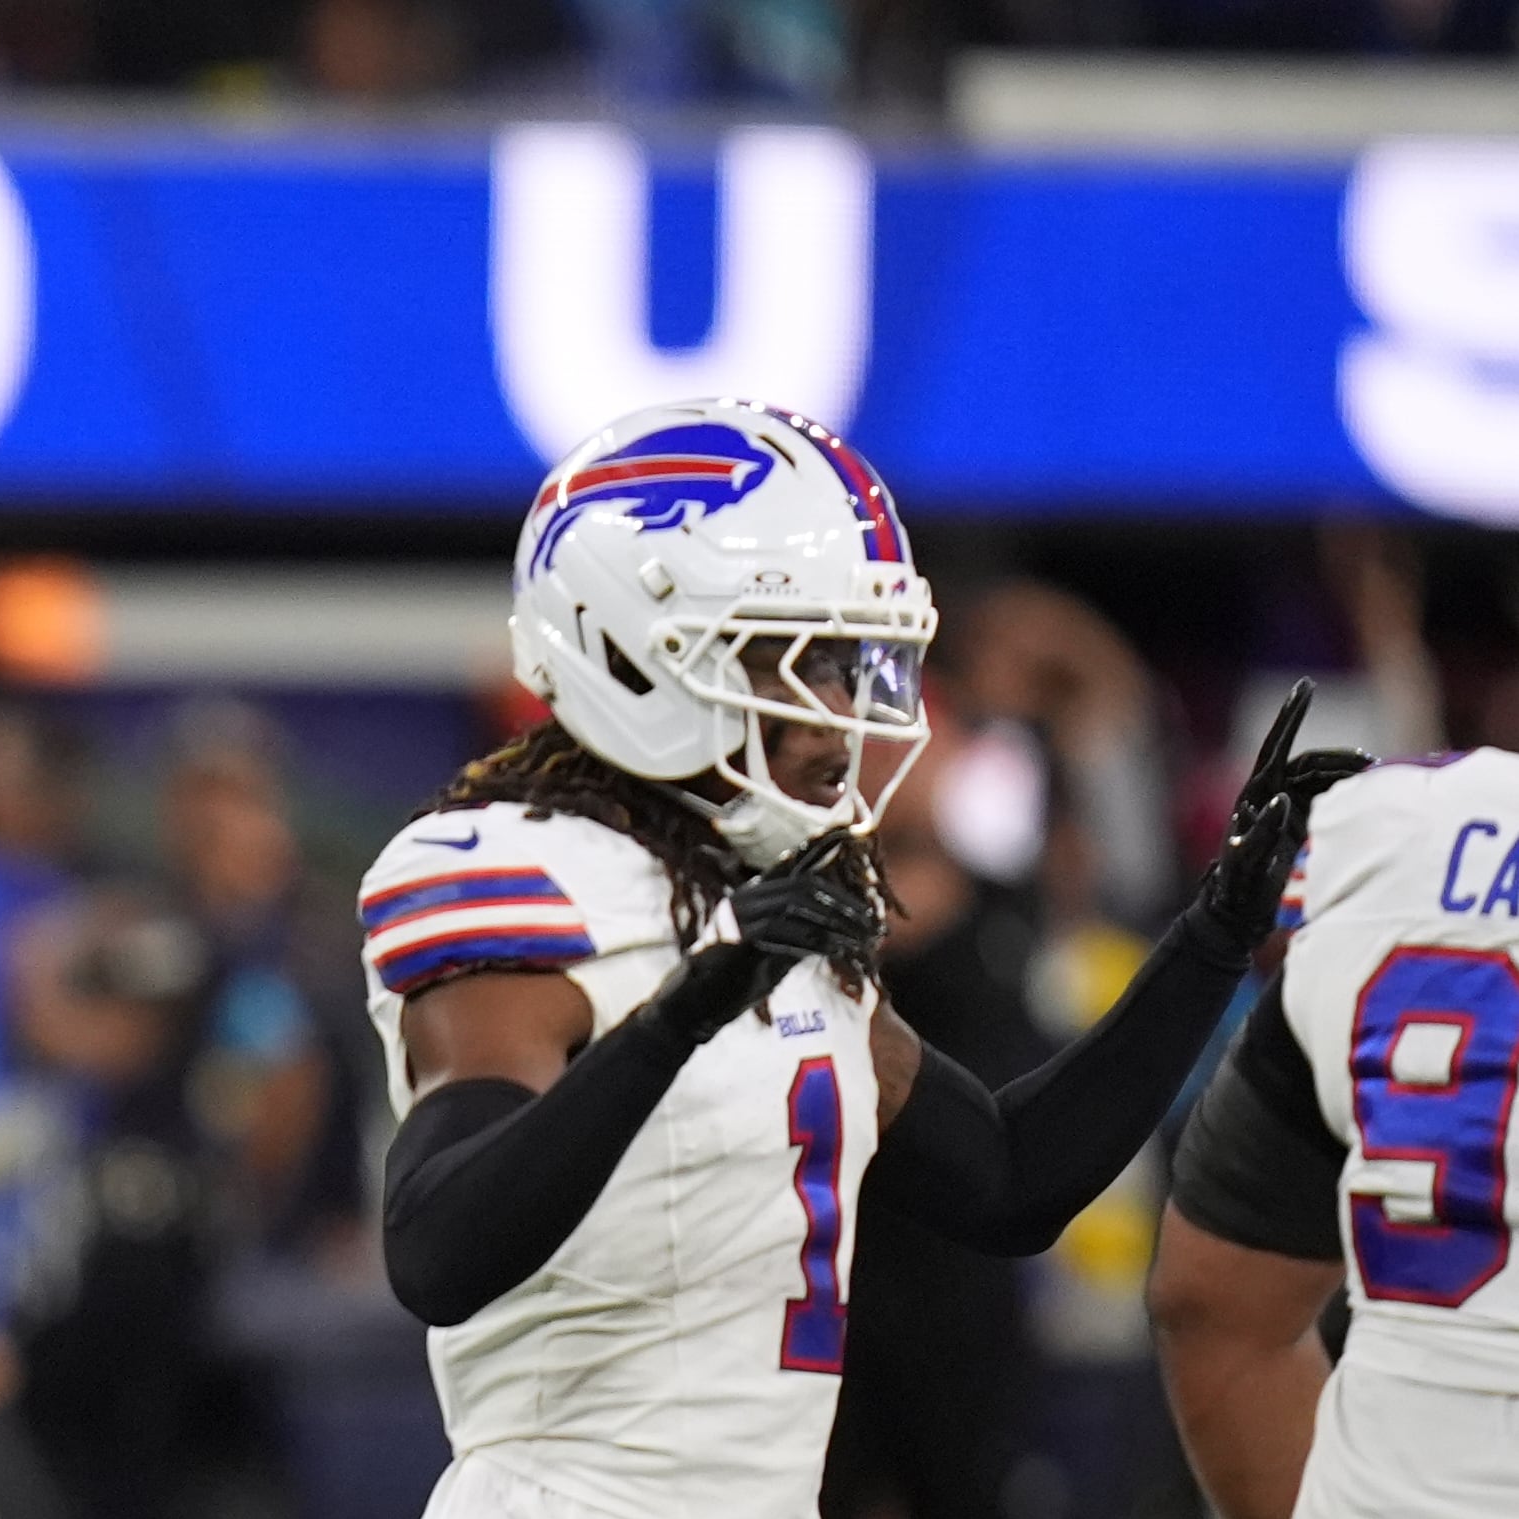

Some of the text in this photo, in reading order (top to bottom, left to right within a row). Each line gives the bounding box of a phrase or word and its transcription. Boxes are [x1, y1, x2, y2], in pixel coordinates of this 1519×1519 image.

[1440, 821, 1519, 917] CA
[775, 1009, 826, 1039] BILLS
[1349, 944, 1519, 1309] 9
[780, 1054, 849, 1376] 1
